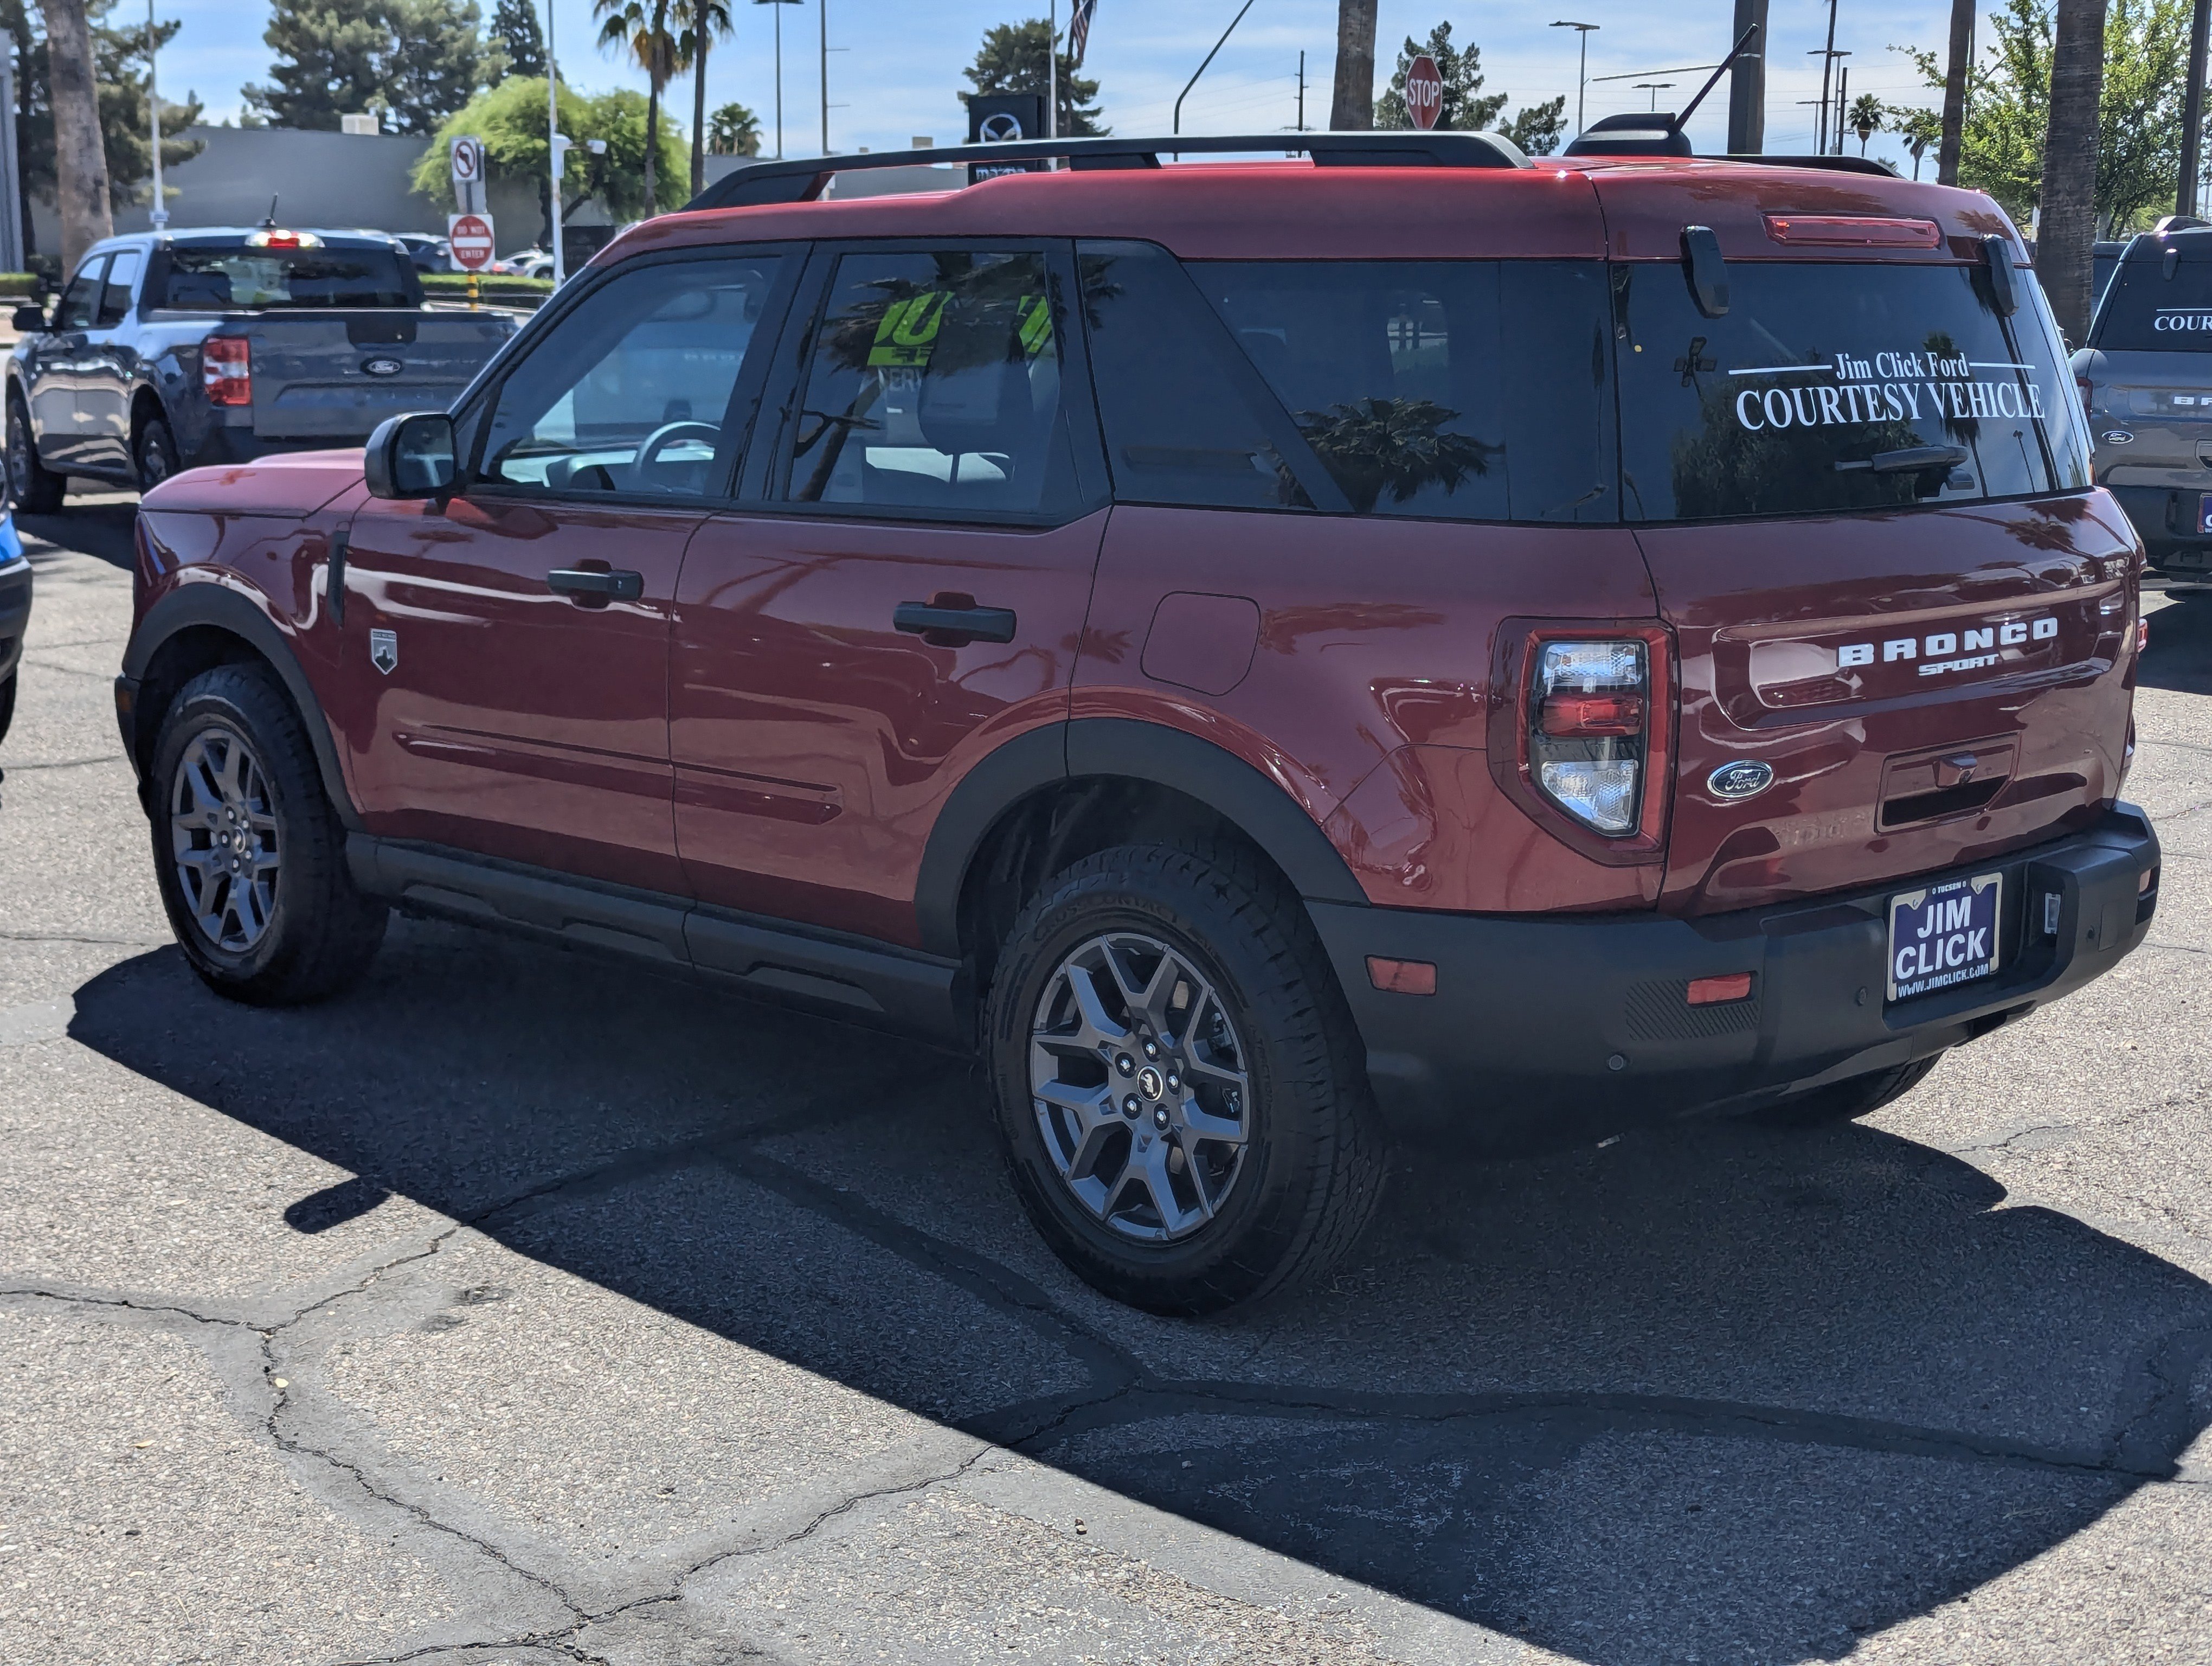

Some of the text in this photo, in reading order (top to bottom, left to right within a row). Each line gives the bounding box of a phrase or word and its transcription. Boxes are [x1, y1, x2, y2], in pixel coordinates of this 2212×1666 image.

[1409, 78, 1440, 108] STOP
[1835, 351, 1970, 380] Jim Click Ford
[1736, 382, 2046, 431] COURTESY VEHICLE
[1838, 617, 2058, 667] BRONCO
[1919, 653, 1999, 676] SPORT
[1725, 768, 1761, 791] Ford
[1917, 895, 1972, 938] JIM
[1895, 927, 1987, 980] CLICK
[1898, 963, 1989, 998] WWW.JIMCLICK.COM
